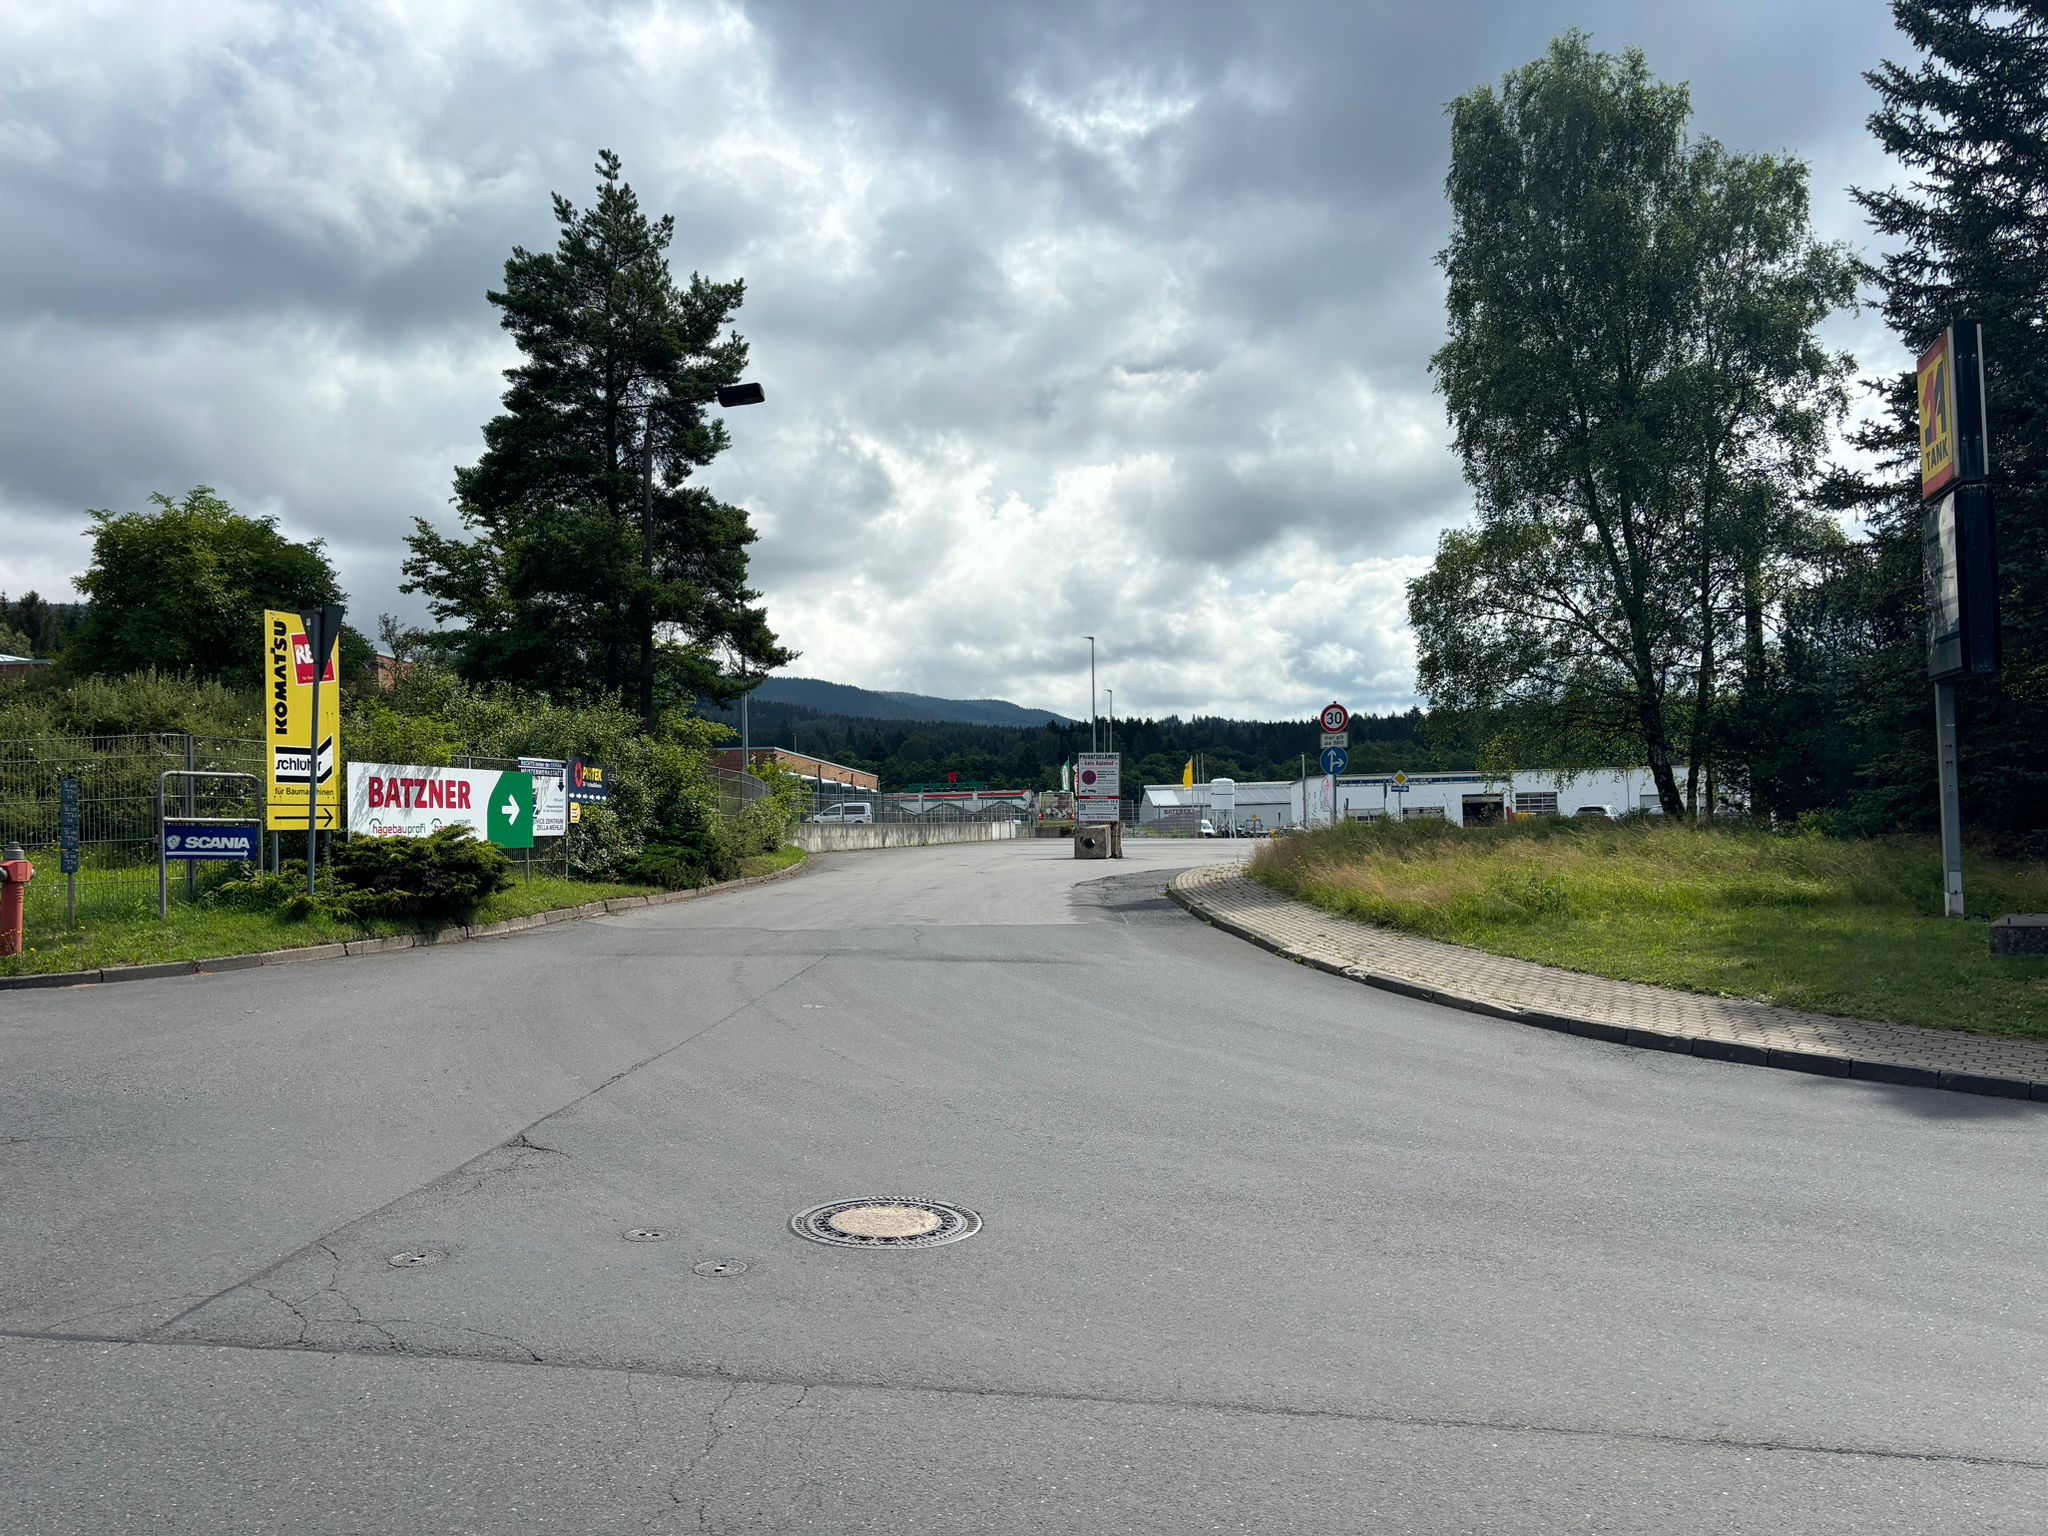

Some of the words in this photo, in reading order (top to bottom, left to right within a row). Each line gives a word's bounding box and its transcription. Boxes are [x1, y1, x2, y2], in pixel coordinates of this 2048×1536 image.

[1926, 437, 1948, 471] TANK
[270, 620, 288, 735] KOMATSU
[1326, 711, 1343, 725] 30
[275, 757, 323, 772] schlütr
[275, 787, 284, 795] für
[286, 787, 334, 796] Baumahinen
[368, 776, 471, 810] BATZNER
[184, 836, 251, 849] SCANIA
